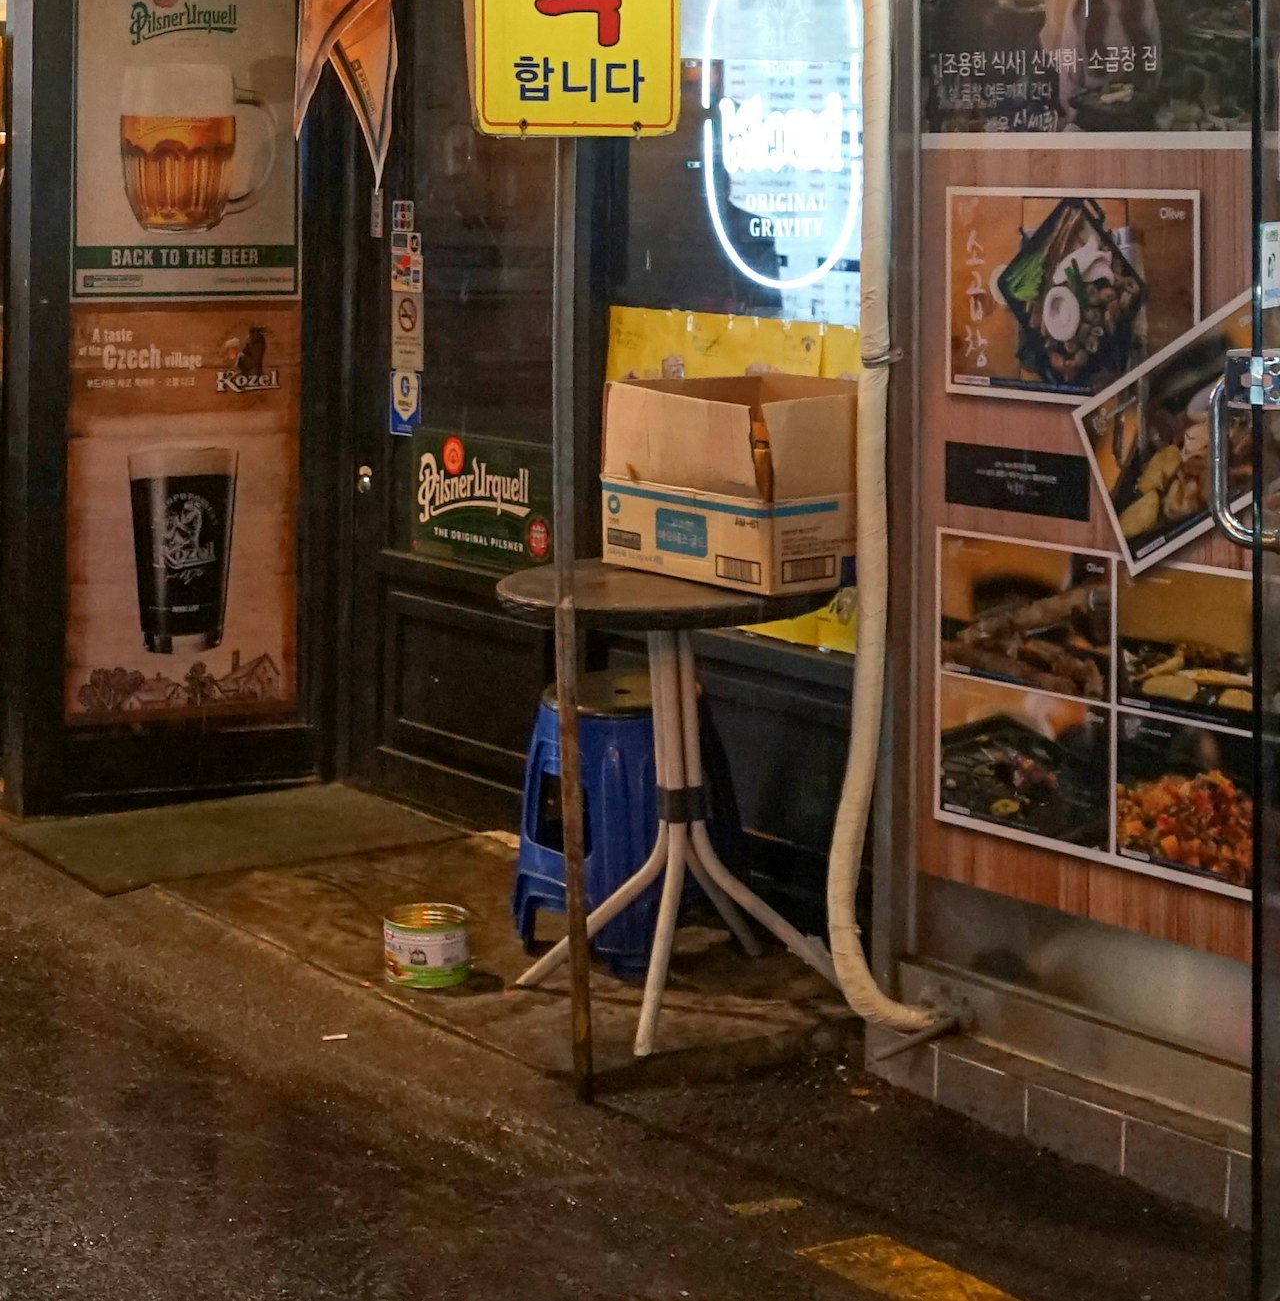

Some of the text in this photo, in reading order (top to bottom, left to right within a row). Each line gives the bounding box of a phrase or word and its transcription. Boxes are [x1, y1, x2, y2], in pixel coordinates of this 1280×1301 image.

[129, 1, 239, 47] Pilsner Urquell
[938, 51, 987, 78] [조용한
[991, 50, 1027, 76] 식사]
[1088, 46, 1137, 73] 소곱창
[1142, 45, 1158, 72] 집
[513, 54, 646, 104] 합니다
[1031, 82, 1053, 100] 간다
[746, 192, 827, 212] ORIGINAL
[1159, 207, 1187, 221] Olive
[749, 217, 825, 237] GRAVITY
[111, 248, 259, 266] BACK TO THE BEER
[92, 328, 133, 343] A taste
[102, 343, 161, 371] Czech
[164, 350, 203, 371] village
[215, 370, 281, 392] Kozel
[418, 452, 529, 523] Pilsner Urquell
[433, 526, 524, 553] THE ORIGINAL PILSNER
